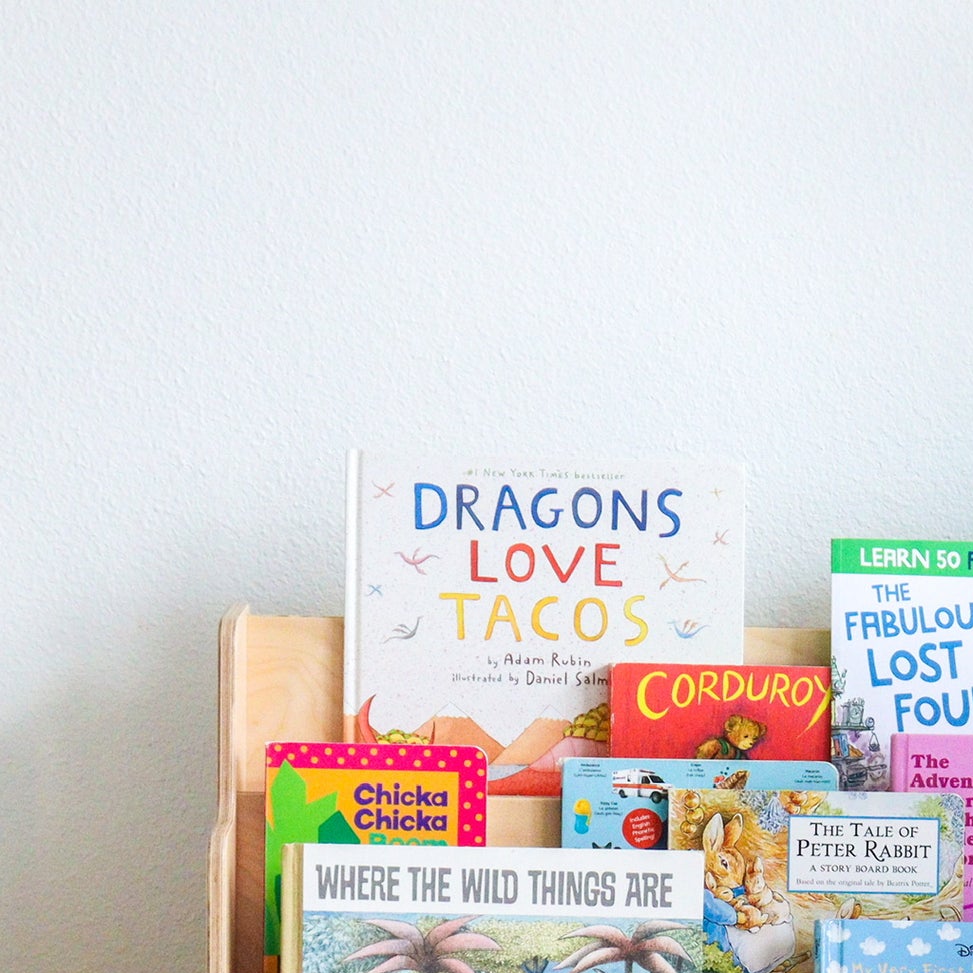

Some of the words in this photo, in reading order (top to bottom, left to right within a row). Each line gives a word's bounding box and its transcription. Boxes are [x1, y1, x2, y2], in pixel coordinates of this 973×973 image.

[413, 482, 683, 538] DRAGONS
[470, 539, 623, 587] LOVE
[860, 547, 930, 569] LEARN
[936, 551, 961, 569] 50
[871, 582, 911, 603] THE
[439, 591, 649, 646] TACOS
[487, 656, 498, 669] by
[504, 653, 545, 666] Adam
[551, 652, 592, 667] Rubin
[867, 639, 963, 687] LOST
[452, 673, 502, 683] illustrated
[508, 673, 519, 686] by
[526, 670, 568, 686] Daniel
[575, 671, 609, 687] Salm
[636, 670, 832, 738] CORDUROY
[910, 754, 949, 769] The
[354, 782, 448, 807] Chicka
[354, 808, 448, 831] Chicka
[899, 826, 919, 838] OF
[809, 864, 817, 872] A
[820, 864, 852, 873] STORY
[855, 864, 889, 873] BOARD
[892, 865, 918, 874] BOOK
[315, 864, 400, 902] WHERE
[407, 866, 452, 902] THE
[461, 868, 518, 904] WILD
[527, 869, 616, 907] THINGS
[625, 872, 673, 908] ARE
[796, 878, 814, 886] Based
[837, 879, 863, 888] original
[864, 879, 875, 887] tale
[877, 880, 885, 888] by
[886, 879, 910, 887] Beatrix
